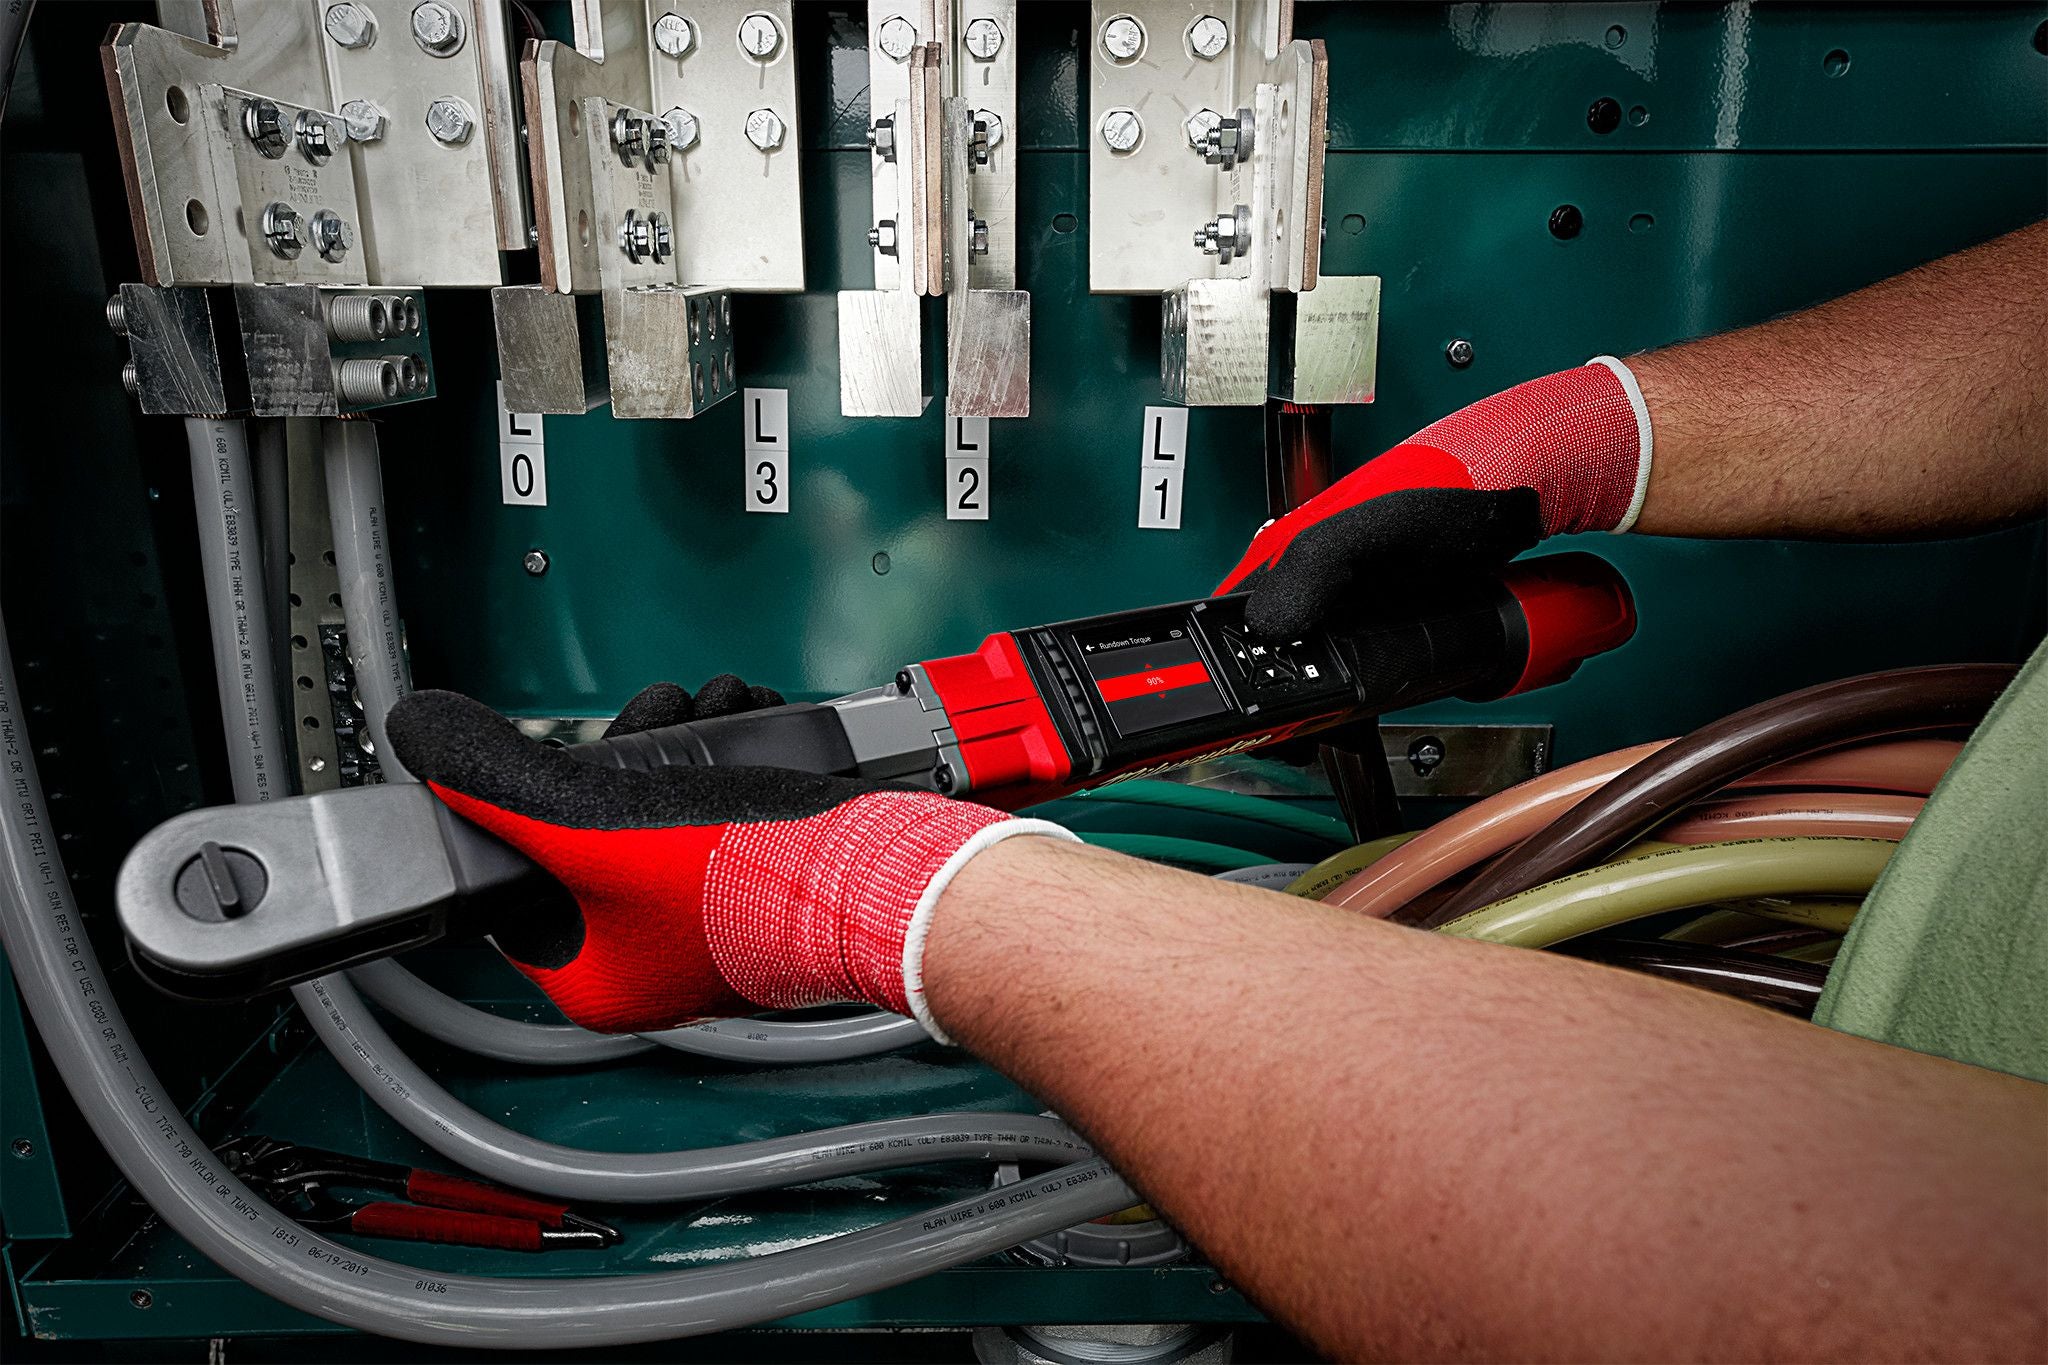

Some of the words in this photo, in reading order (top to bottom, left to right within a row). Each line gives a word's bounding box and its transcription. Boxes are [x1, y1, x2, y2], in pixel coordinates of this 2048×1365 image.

[509, 413, 532, 436] L
[755, 398, 777, 443] L
[957, 417, 978, 451] L
[1154, 416, 1175, 461] L
[216, 437, 227, 454] 600
[218, 458, 231, 485] KCMIL
[512, 453, 534, 497] 0
[756, 461, 778, 505] 3
[958, 467, 979, 510] 2
[1154, 478, 1168, 520] 1
[225, 514, 238, 546] E83039
[229, 550, 241, 571] TYPE
[376, 563, 385, 578] 600
[378, 581, 388, 606] KCMIL
[235, 600, 245, 611] OR
[1099, 640, 1130, 650] Rundown
[1129, 637, 1152, 648] Torque
[1252, 646, 1267, 656] OK
[241, 649, 251, 660] OR
[391, 663, 401, 682] TYPE
[1147, 676, 1165, 686] 90%
[11, 760, 23, 774] OR
[15, 778, 30, 798] MTW
[257, 773, 267, 788] RES
[260, 791, 270, 801] FO
[47, 891, 63, 911] SUN
[55, 913, 71, 934] RES
[64, 936, 79, 957] FOR
[72, 960, 86, 973] CT
[80, 976, 96, 997] USE
[89, 1000, 109, 1024] 600V
[102, 1027, 117, 1041] OR
[156, 1115, 178, 1140] TYPE
[175, 1140, 193, 1159] T90
[868, 1141, 885, 1151] 600
[888, 1138, 913, 1149] KCMIL
[940, 1133, 970, 1144] E83039
[974, 1133, 993, 1142] TYPE
[1019, 1135, 1029, 1144] OR
[189, 1158, 218, 1186] NYLON
[216, 1184, 231, 1199] OR
[922, 1217, 947, 1231] ALAN
[950, 1208, 974, 1222] WIRE
[988, 1198, 1006, 1211] 600
[1008, 1189, 1038, 1205] KCMIL
[1041, 1180, 1062, 1194] (UL)
[1066, 1169, 1098, 1187] E83039
[230, 1195, 260, 1221] TWN75
[271, 1226, 301, 1247] 18:51
[308, 1246, 369, 1276] 06/19/2019
[415, 1280, 447, 1294] 01036
